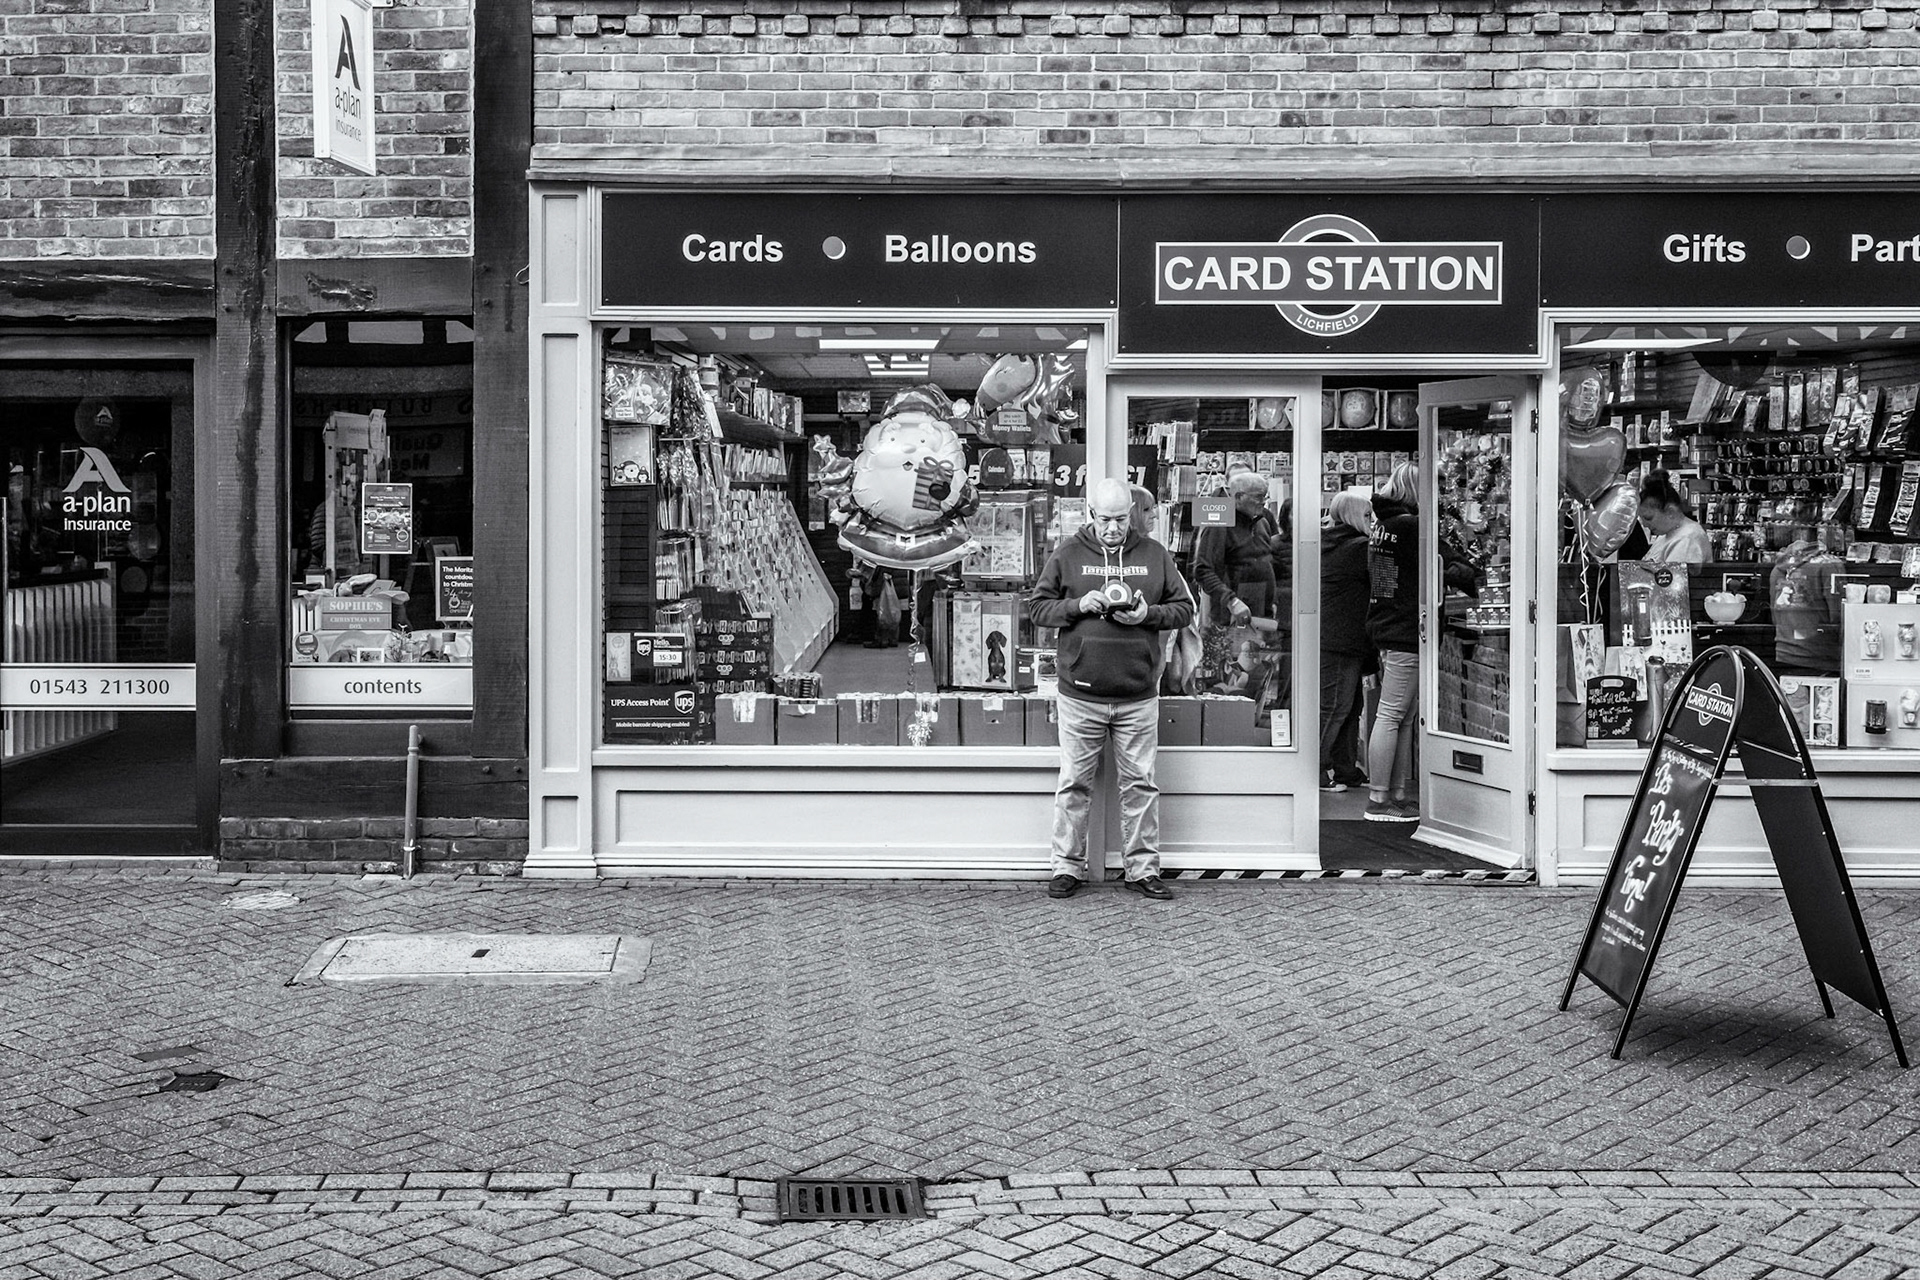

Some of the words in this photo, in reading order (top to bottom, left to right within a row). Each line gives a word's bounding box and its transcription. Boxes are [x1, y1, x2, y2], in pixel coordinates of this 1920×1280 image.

[335, 86, 361, 119] a-plan
[335, 116, 361, 142] insurance
[683, 234, 783, 262] Cards
[886, 235, 1036, 263] Balloons
[1664, 234, 1745, 262] Gifts
[1165, 257, 1291, 290] CARD
[1306, 256, 1493, 290] STATION
[1296, 314, 1360, 333] LICHFIELD
[992, 424, 1010, 432] Money
[1054, 465, 1071, 486] 3
[63, 492, 130, 516] a-plan
[65, 518, 131, 530] insurance
[442, 565, 453, 573] The
[1081, 565, 1149, 576] Lambretta
[329, 601, 384, 611] SOPHIE'S
[30, 680, 87, 694] 01543
[101, 680, 169, 694] 211300
[345, 680, 421, 693] contents
[611, 699, 626, 707] UPS
[626, 699, 649, 707] Access
[1689, 691, 1708, 708] CARD
[1706, 697, 1733, 718] STATION
